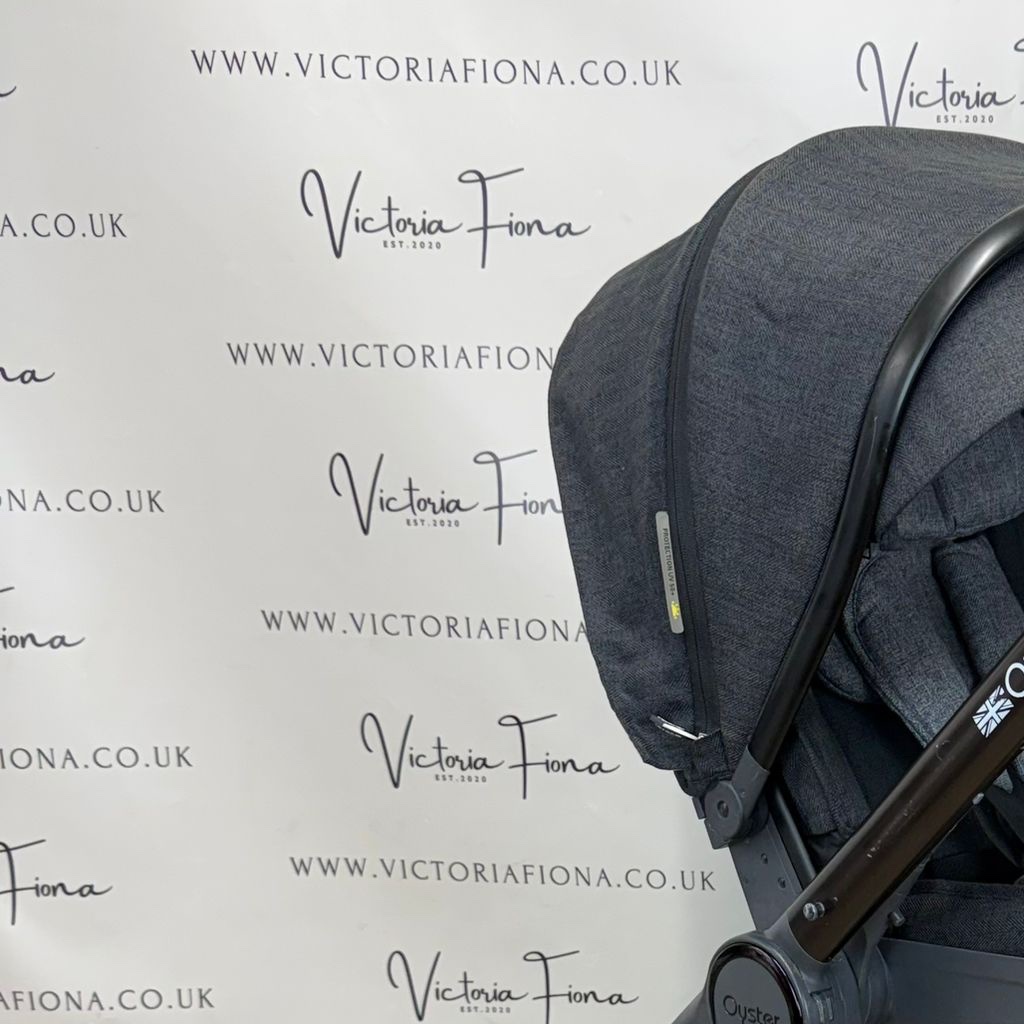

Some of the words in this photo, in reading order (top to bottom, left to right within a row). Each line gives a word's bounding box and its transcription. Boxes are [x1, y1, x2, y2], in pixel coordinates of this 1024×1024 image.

[191, 49, 682, 86] WWW.VICTORIAFIONA.CO.UK
[856, 41, 1016, 127] Victoria
[936, 115, 994, 123] EST.2020
[300, 169, 463, 259] Victoria
[458, 168, 591, 269] Fiona
[383, 240, 441, 249] EST.2020
[0, 489, 164, 513] NA.CO.UK
[329, 452, 479, 536] Victoria
[406, 518, 459, 527] EST.2020
[360, 712, 503, 789] Victoria
[498, 713, 621, 800] Fiona
[435, 774, 486, 783] EST.2020
[0, 839, 113, 926] Fiona
[289, 857, 716, 891] WWW.VICTORIAFIONA.CO.UK
[386, 950, 527, 1022] Victoria
